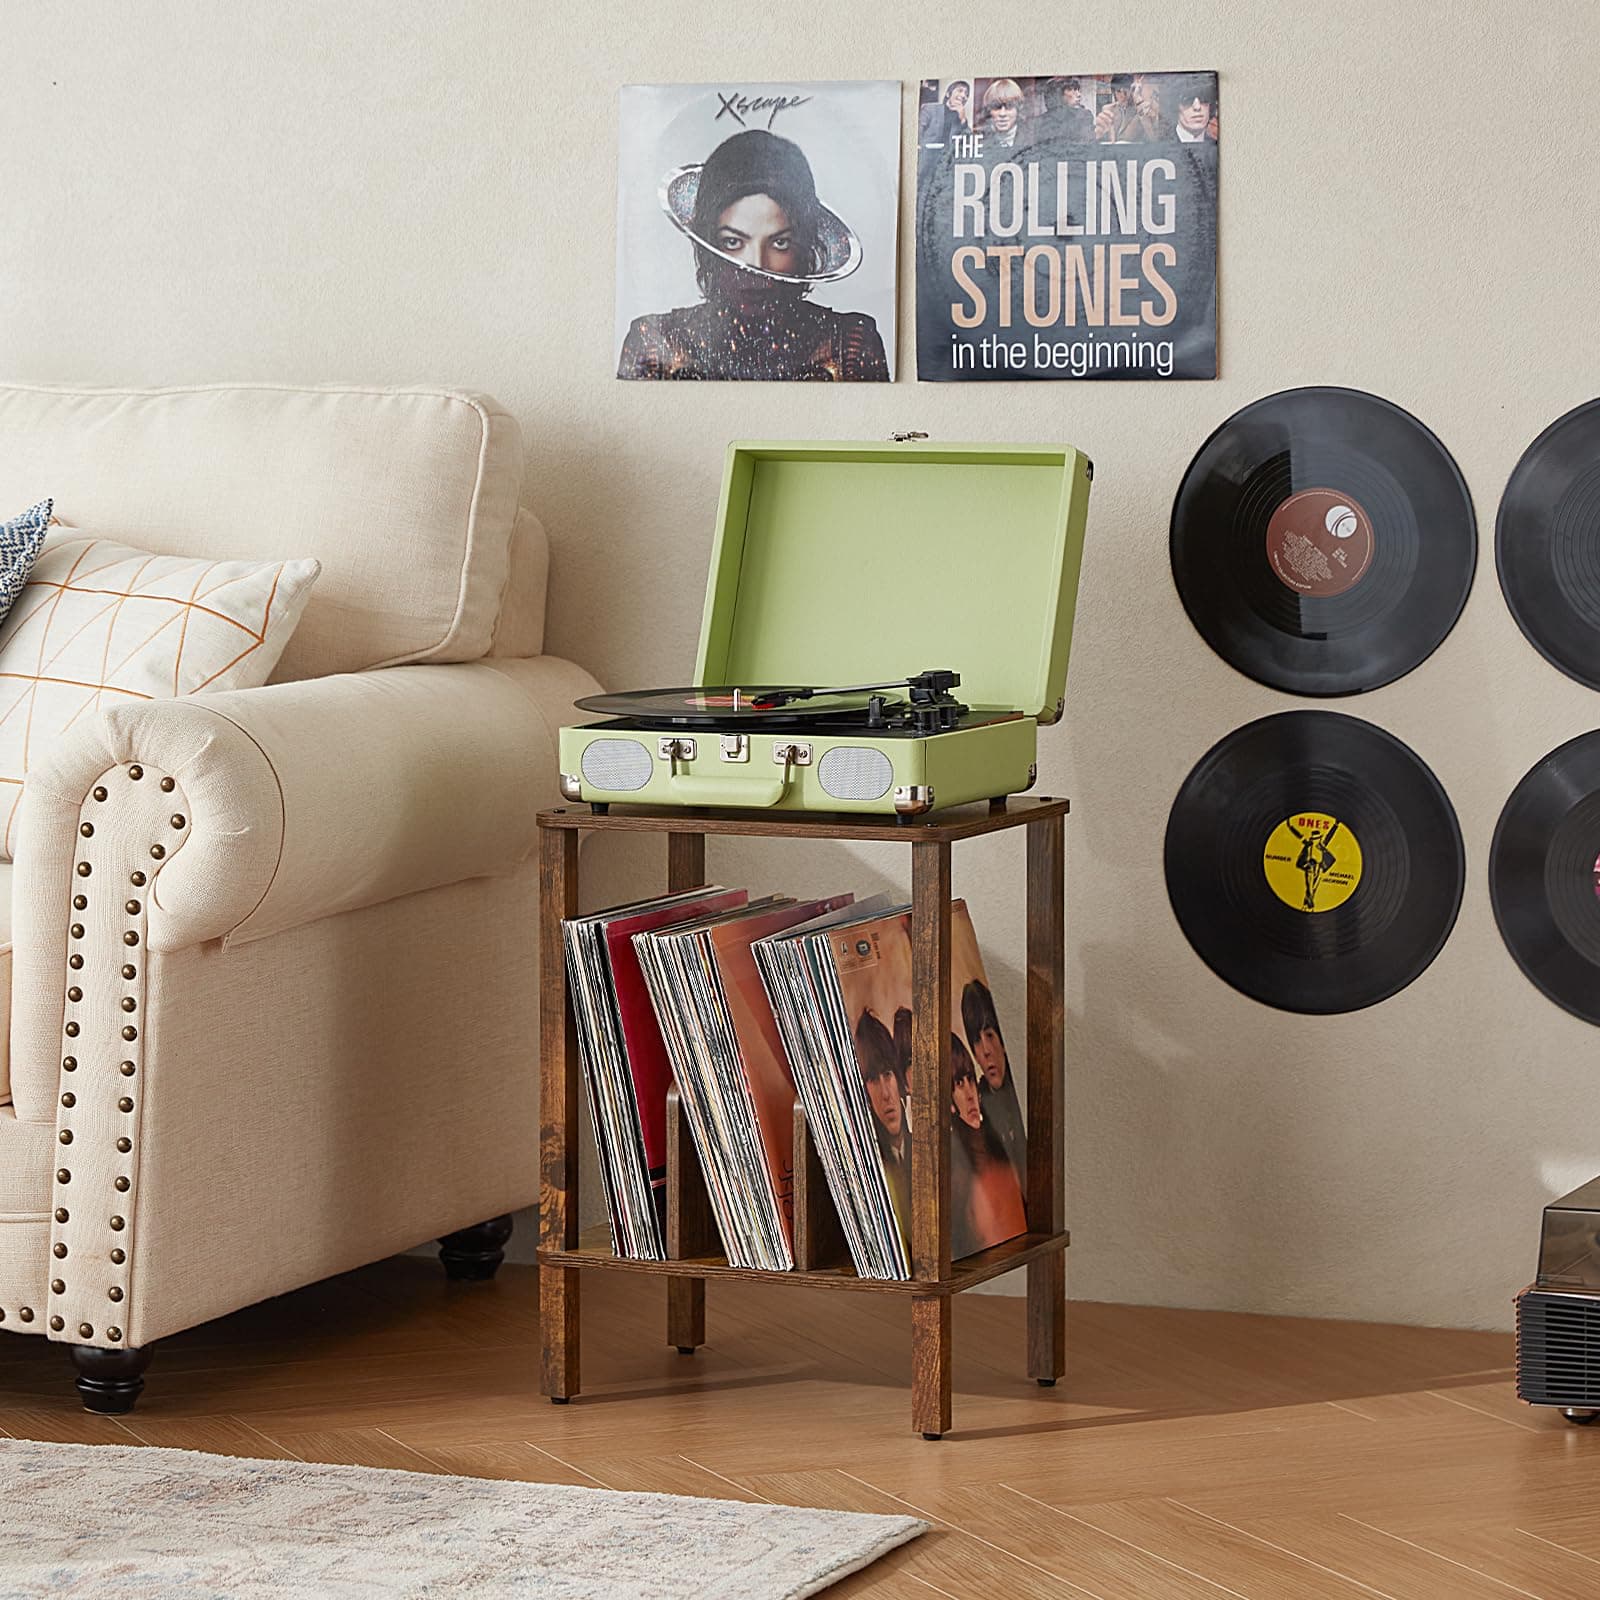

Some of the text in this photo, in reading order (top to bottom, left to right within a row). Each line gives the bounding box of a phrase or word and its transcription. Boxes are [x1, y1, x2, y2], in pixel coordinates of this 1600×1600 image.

[714, 92, 814, 129] Xscape
[951, 134, 984, 159] THE
[952, 158, 1177, 238] ROLLING
[951, 243, 1178, 328] STONES
[951, 333, 1175, 377] in the beginning
[1298, 817, 1330, 830] ONES
